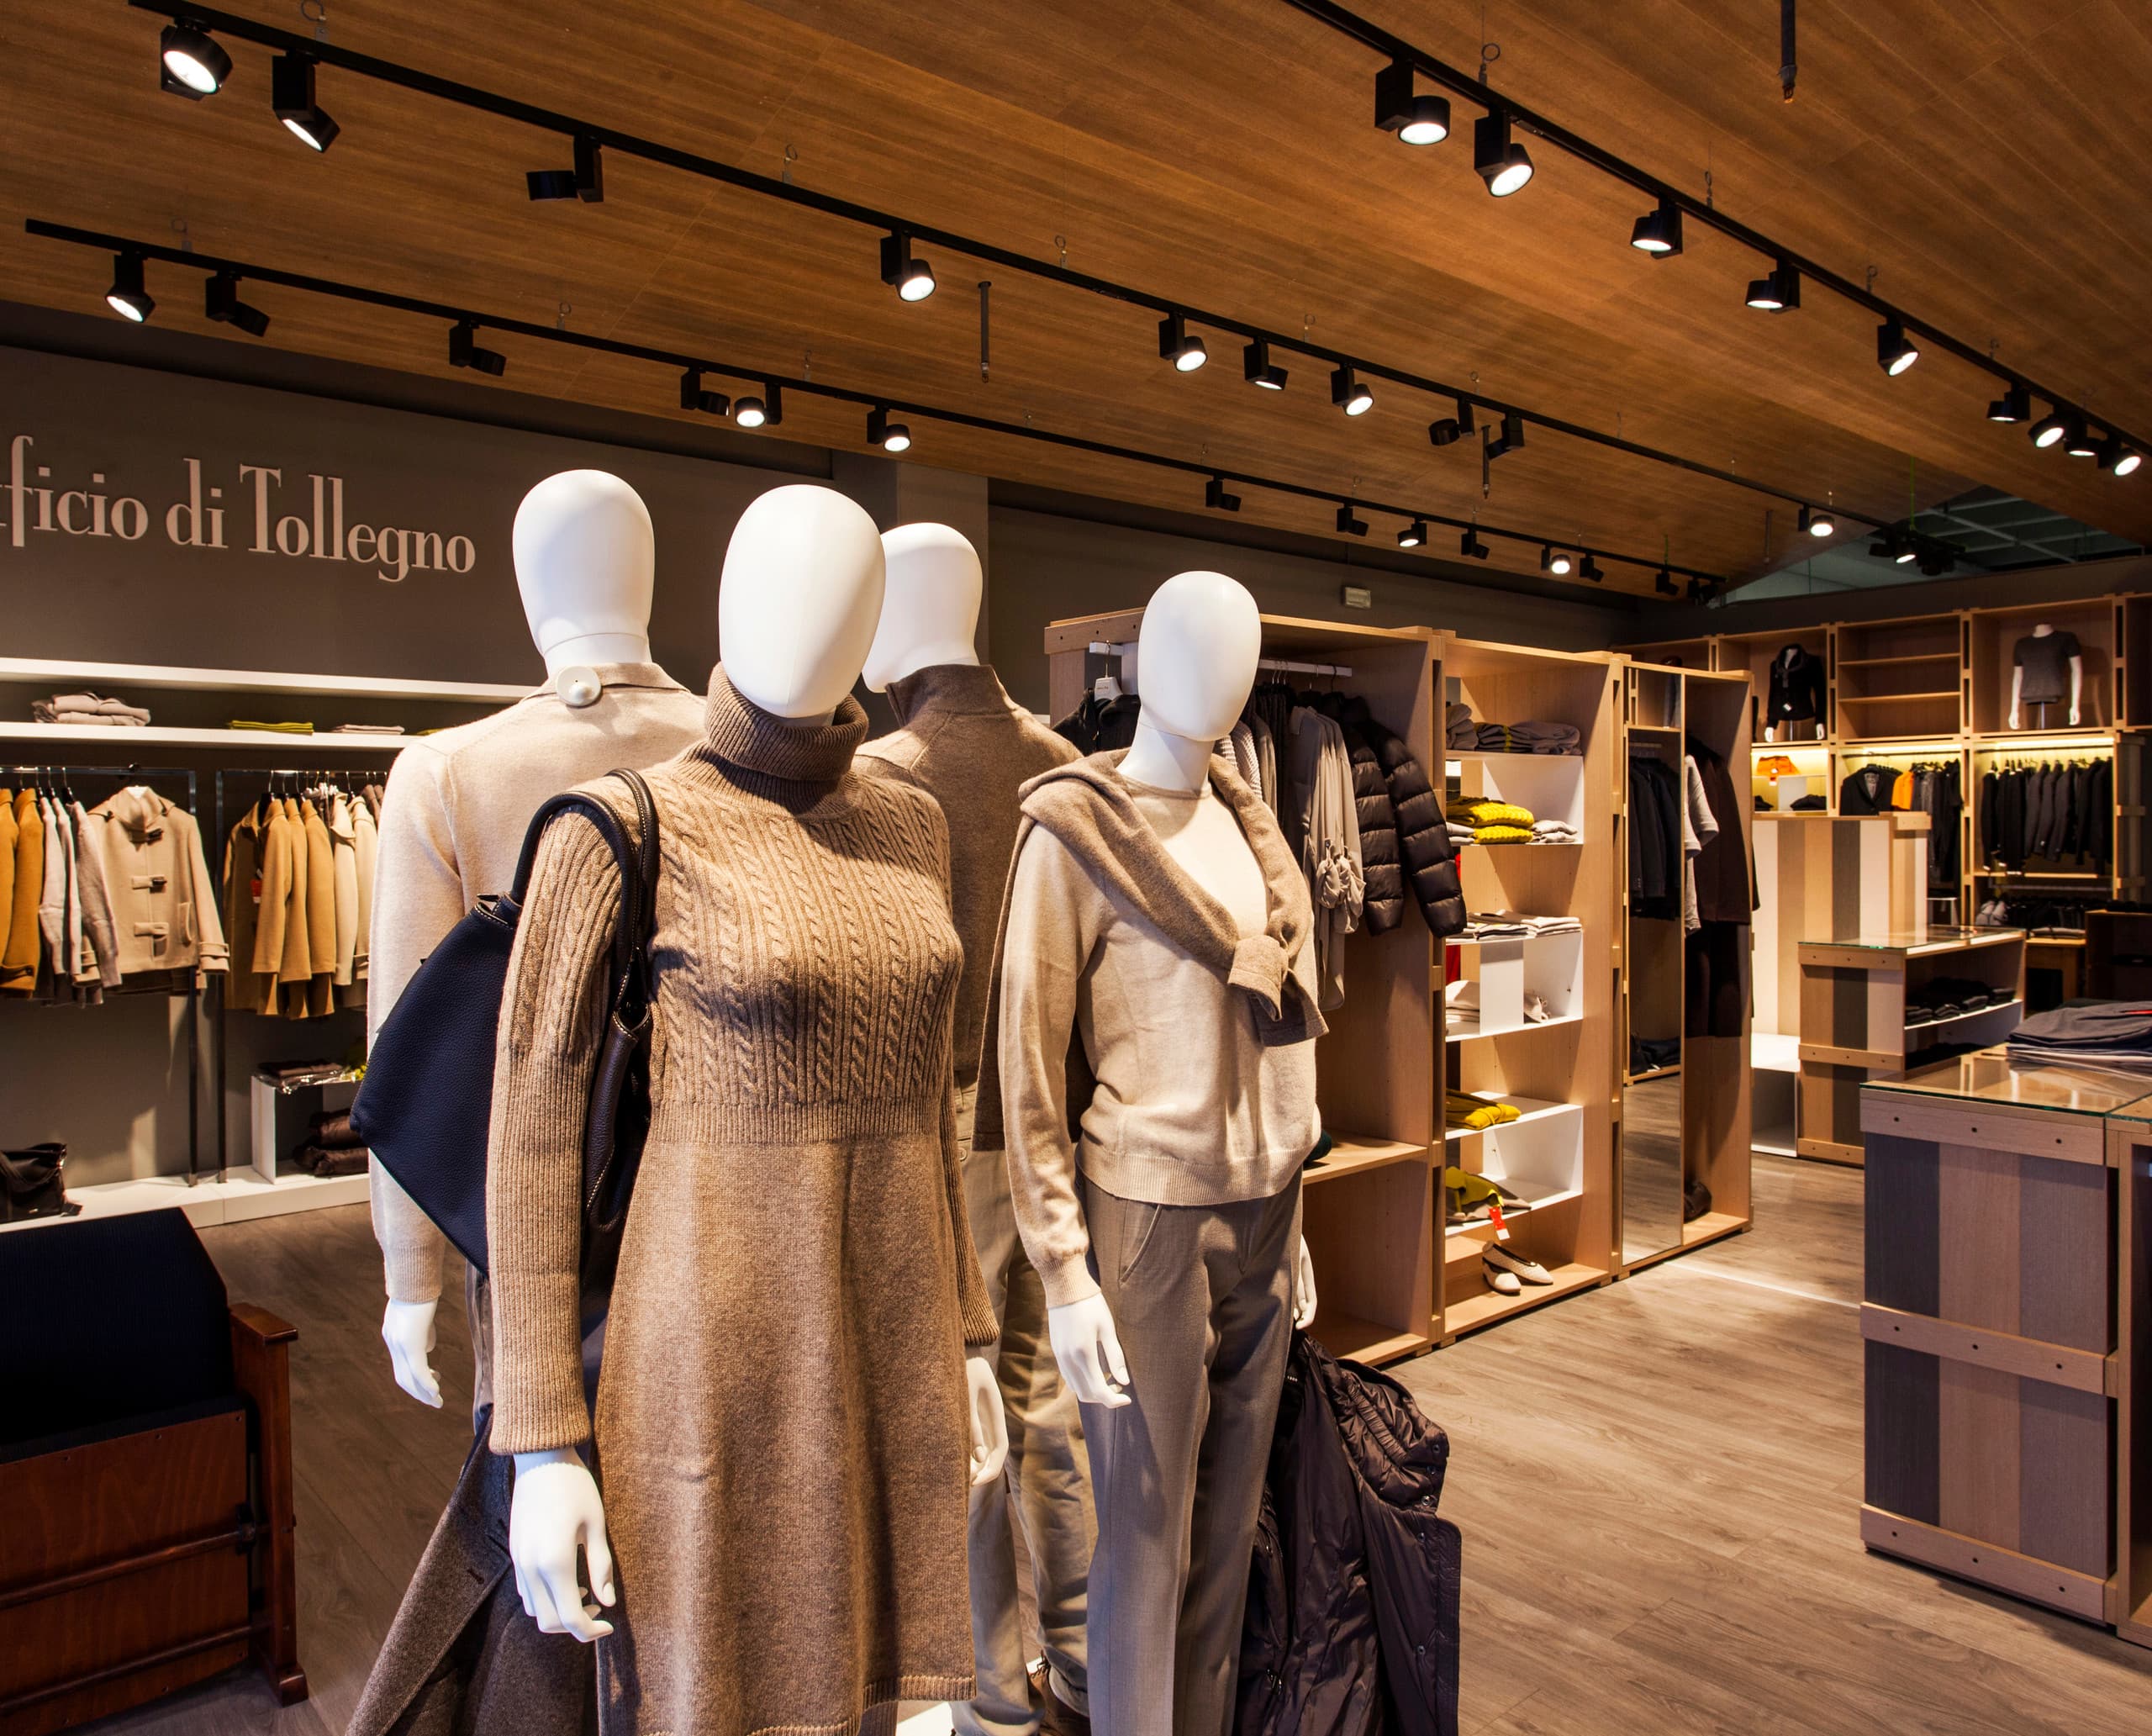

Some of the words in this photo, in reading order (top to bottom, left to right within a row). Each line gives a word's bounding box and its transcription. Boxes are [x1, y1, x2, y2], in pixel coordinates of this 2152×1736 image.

[0, 435, 149, 547] ficio
[166, 458, 229, 549] di
[240, 464, 476, 583] Tollegno
